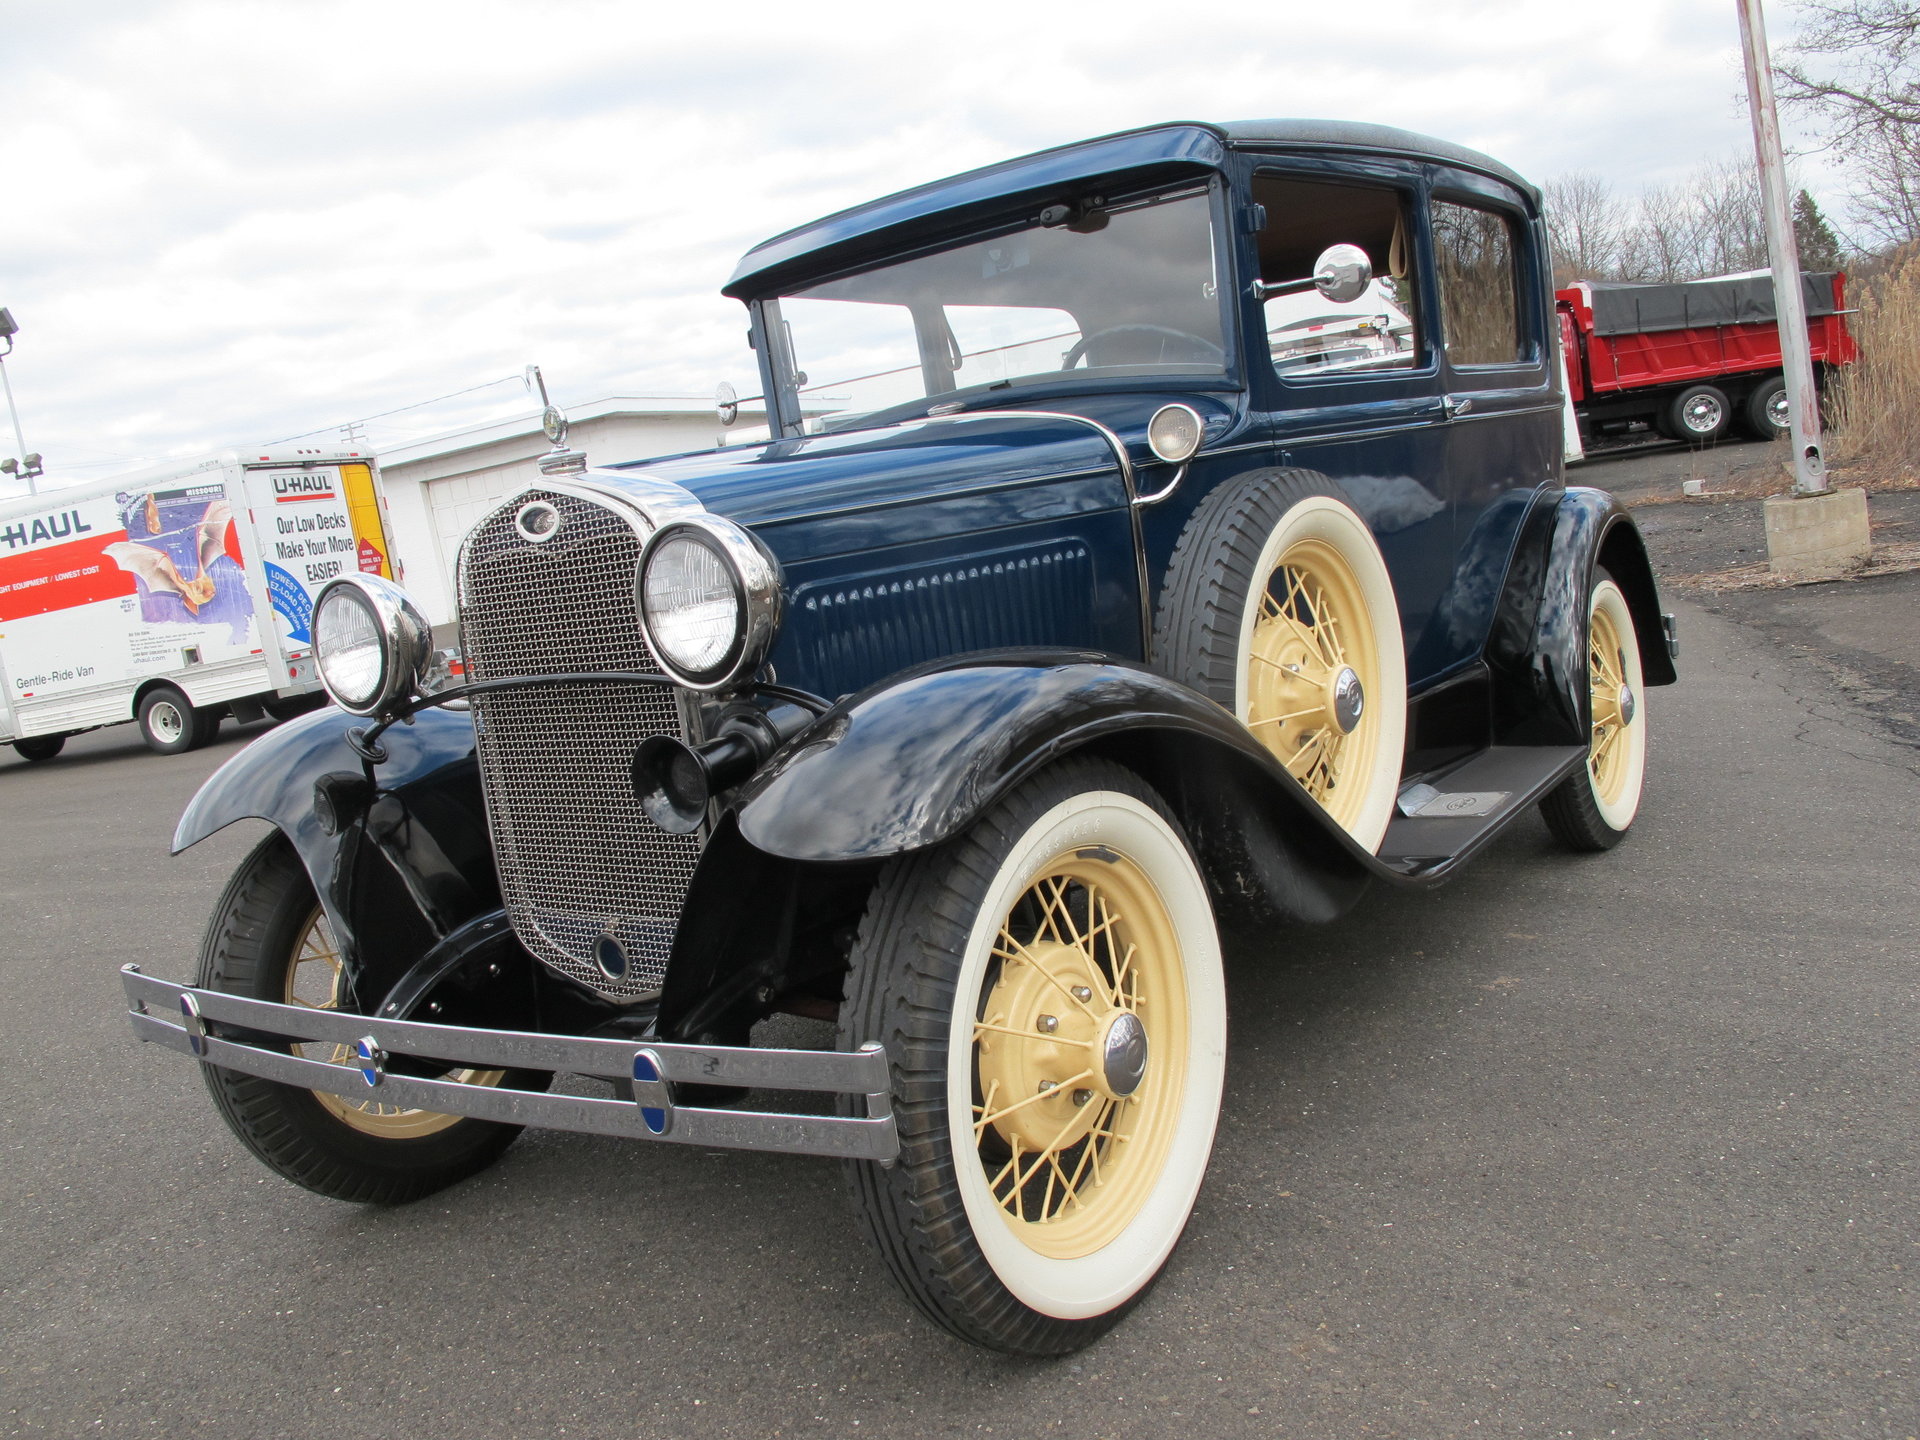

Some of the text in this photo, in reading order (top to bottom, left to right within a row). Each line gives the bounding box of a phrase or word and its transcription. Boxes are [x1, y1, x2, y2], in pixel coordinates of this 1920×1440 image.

[186, 485, 223, 497] MISSOURI
[274, 475, 332, 494] U-HAUL
[276, 512, 346, 535] Our Low Decks
[275, 535, 354, 560] Make Your Move
[12, 577, 49, 591] EQUIPMENT
[54, 569, 81, 582] LOWEST
[81, 565, 100, 576] COST
[271, 569, 298, 593] LOWEST
[289, 610, 302, 631] WORK
[16, 666, 95, 689] Gentle-Ride Van
